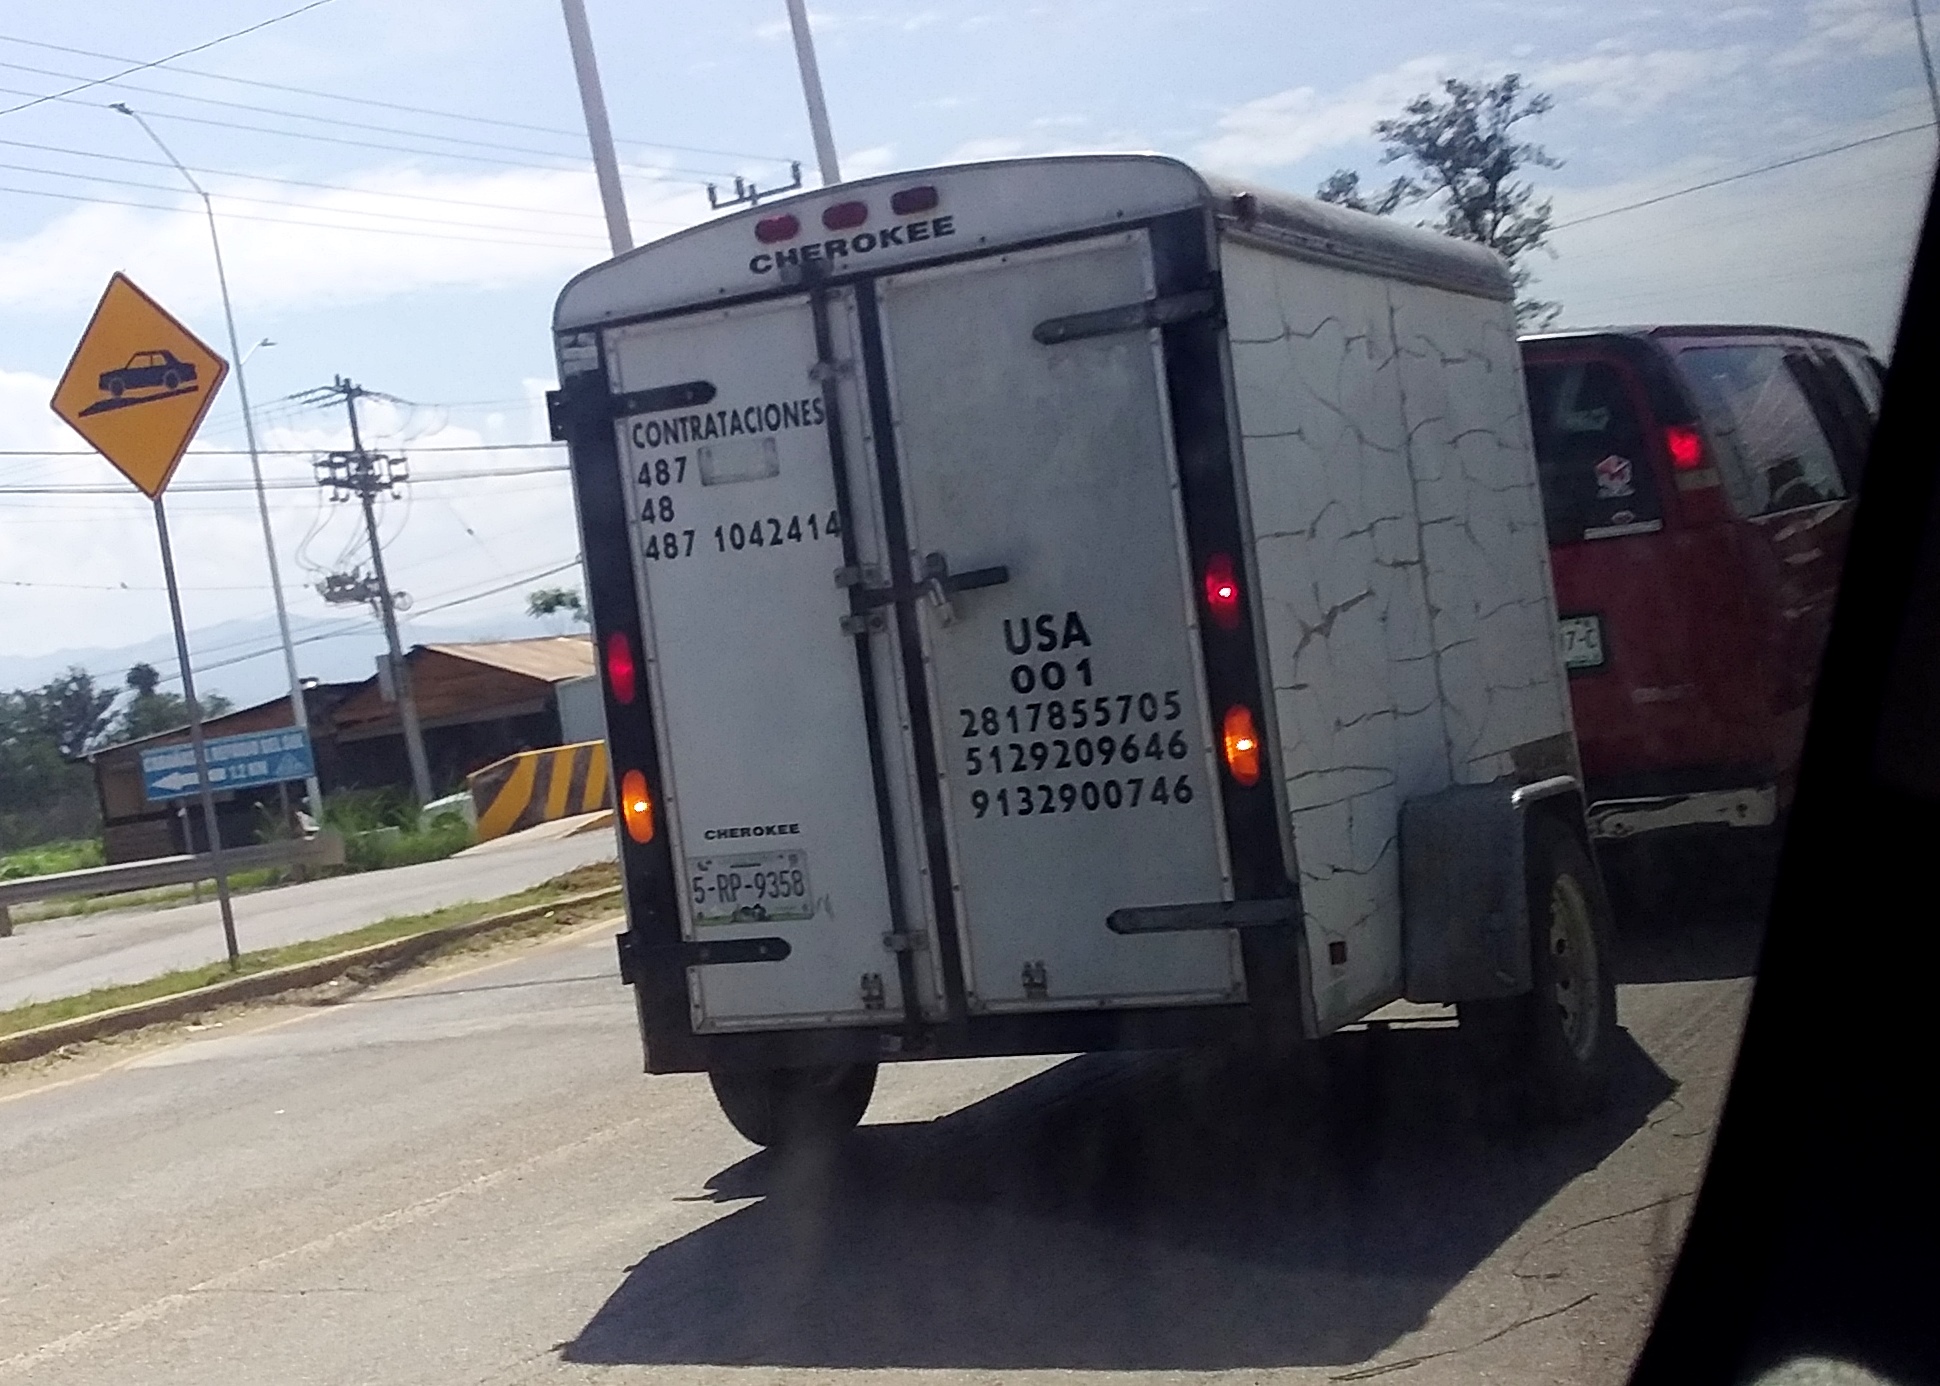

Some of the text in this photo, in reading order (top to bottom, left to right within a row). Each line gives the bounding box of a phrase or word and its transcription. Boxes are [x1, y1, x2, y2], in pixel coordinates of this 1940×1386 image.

[749, 215, 956, 274] CHEROKEE
[632, 397, 826, 449] CONTRATACIONES
[638, 456, 687, 487] 487
[641, 496, 675, 523] 48
[645, 510, 842, 560] 487 1042414
[1003, 611, 1092, 655] USA
[959, 690, 1182, 738] 2817855705
[966, 729, 1188, 776] 5129209646
[971, 774, 1193, 819] 9132900746
[704, 823, 800, 841] CHEROKEE
[692, 869, 805, 904] 5-RP-9358
